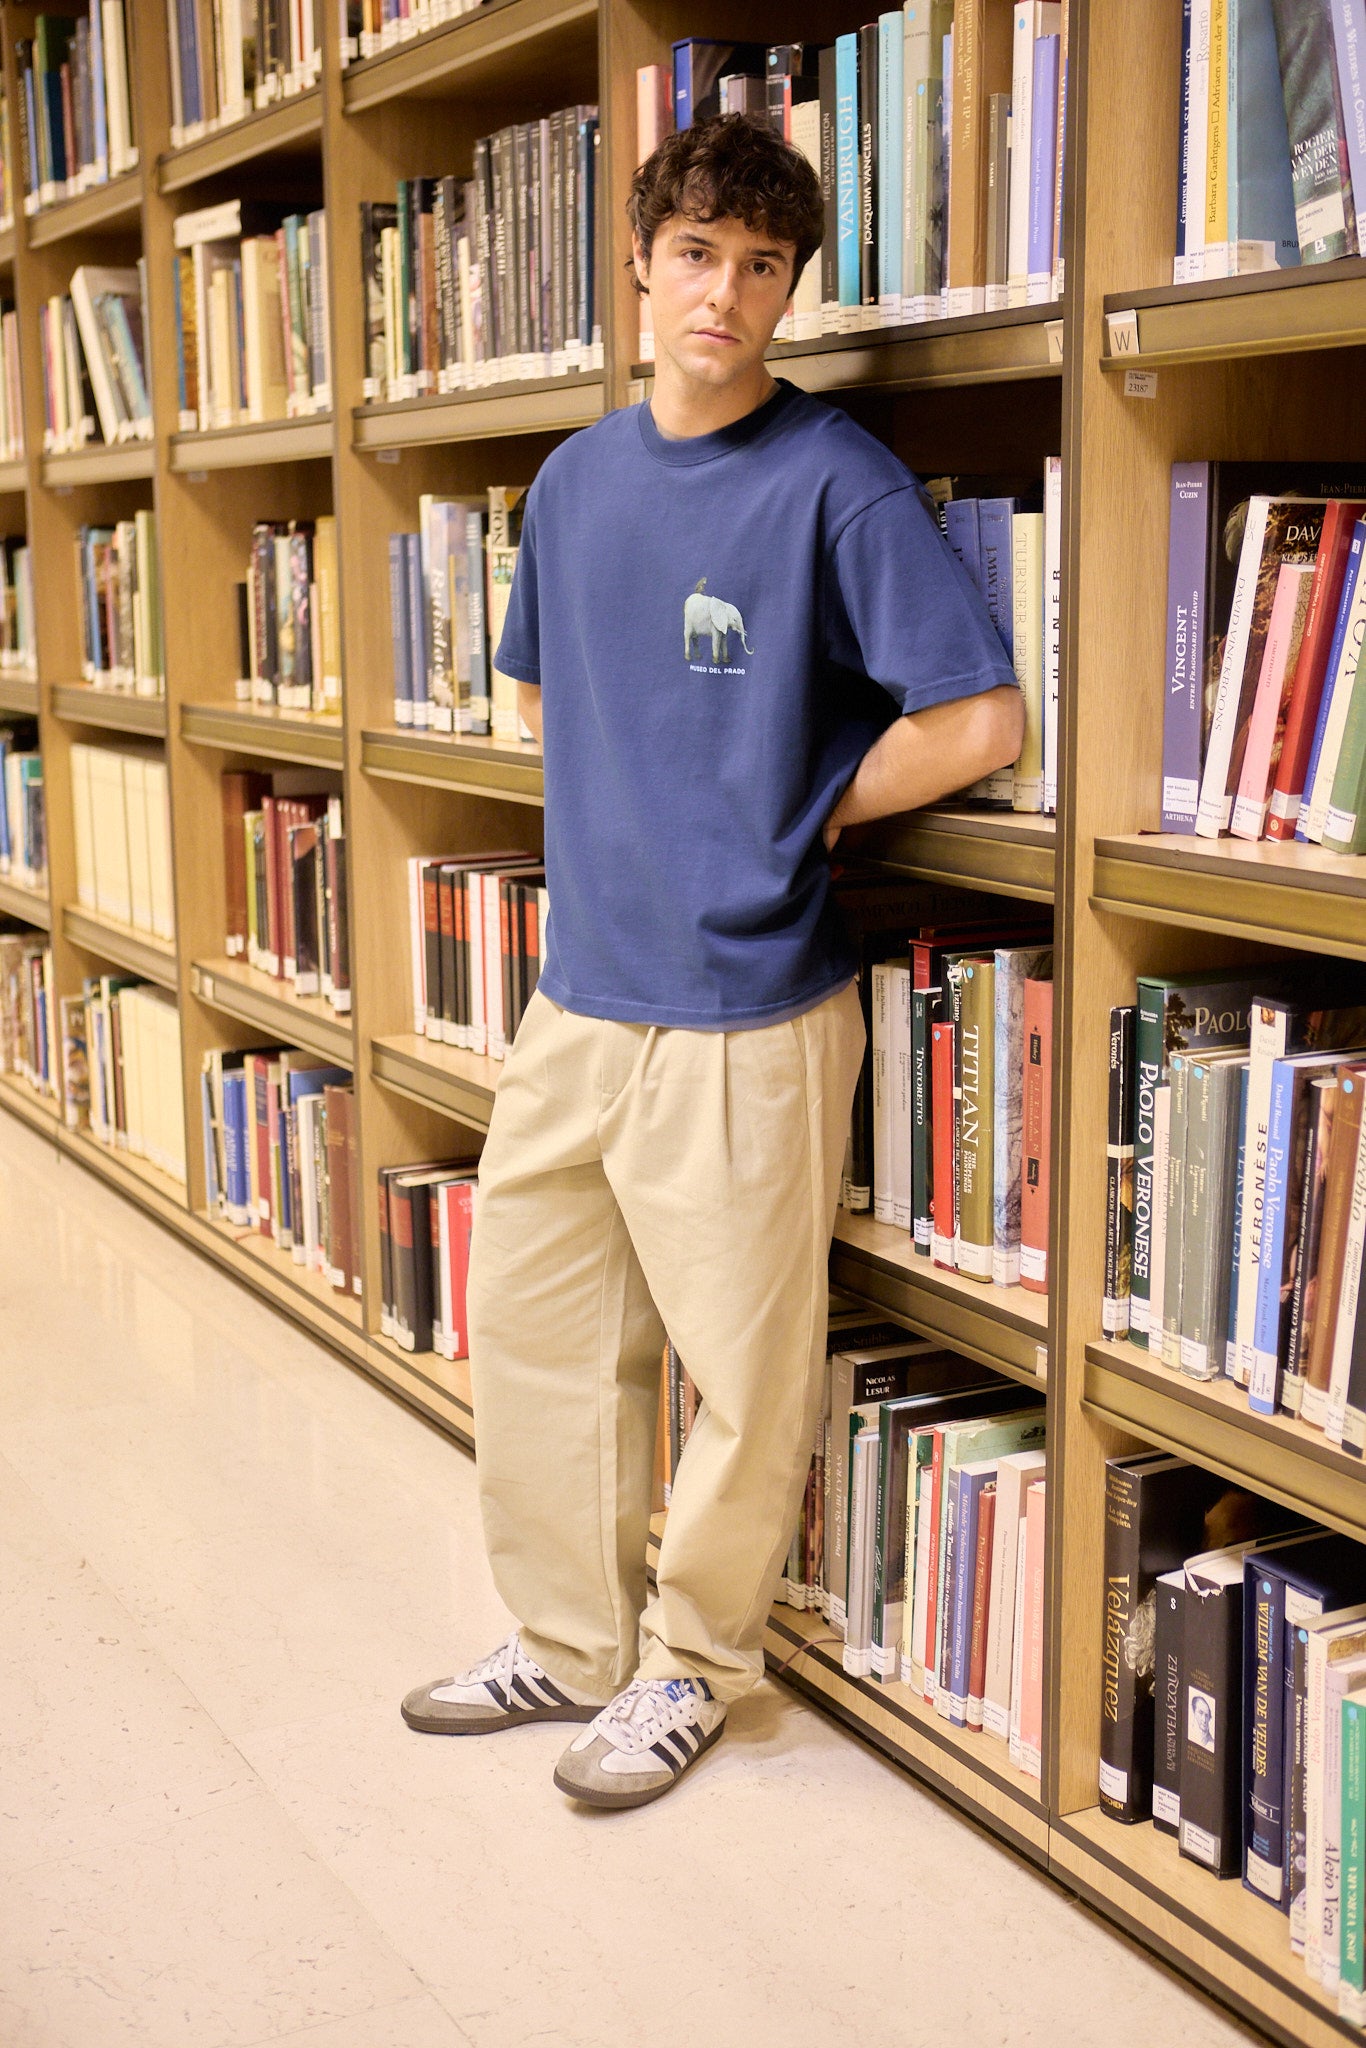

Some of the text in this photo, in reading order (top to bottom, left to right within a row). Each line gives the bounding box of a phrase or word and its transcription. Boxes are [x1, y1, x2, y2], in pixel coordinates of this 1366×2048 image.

[1214, 24, 1223, 42] der
[1214, 44, 1223, 63] van
[963, 66, 973, 100] Luigi
[1212, 66, 1222, 108] Adriaen
[822, 112, 831, 173] VALLOTTON
[1210, 125, 1221, 181] Gaehtgens
[1293, 129, 1336, 156] ROGIER
[1313, 141, 1337, 162] DER
[839, 95, 854, 242] VANBRUGH
[862, 123, 874, 245] JOAQUIM VANCELLS
[1209, 183, 1218, 223] Barbara
[1113, 330, 1131, 352] W
[1127, 382, 1149, 393] 23187
[1179, 490, 1199, 499] CUZIN
[1015, 532, 1027, 625] TURNER
[690, 665, 708, 673] MUSEO
[724, 667, 746, 675] PRADO
[1171, 605, 1188, 695] VINCENT
[1189, 590, 1200, 710] ENTRE FRAGONARD ET DAVID
[1214, 577, 1247, 731] DAVID VINCKBOONS
[1165, 813, 1193, 823] ARTHENA
[954, 985, 962, 1022] Tiziano
[1110, 1030, 1121, 1070] Veronés
[916, 1046, 925, 1126] TINTORETTO
[962, 1024, 979, 1147] TITIAN
[1133, 1060, 1159, 1279] PAOLO VERONESE
[1251, 1121, 1268, 1266] VÉRONÈSE
[1262, 1084, 1285, 1270] David Rosand Paolo Veronese
[865, 1386, 890, 1397] LESUR
[866, 1375, 896, 1386] NICOLAS
[678, 1381, 686, 1429] Ludovico
[834, 1453, 843, 1558] Pierre SUBLEYRAS
[946, 1499, 956, 1556] Agostino Tassi
[1108, 1504, 1116, 1514] La
[977, 1535, 986, 1565] David
[975, 1601, 983, 1617] the
[971, 1618, 981, 1658] Younger
[1102, 1573, 1131, 1723] Velázquez
[1165, 1653, 1179, 1737] VELÁZQUEZ
[1254, 1601, 1269, 1778] WILLEM VAN DE VELDES
[1294, 1694, 1303, 1765] L'OPERA COMPLETA
[1322, 1838, 1340, 1937] Alejo Vera
